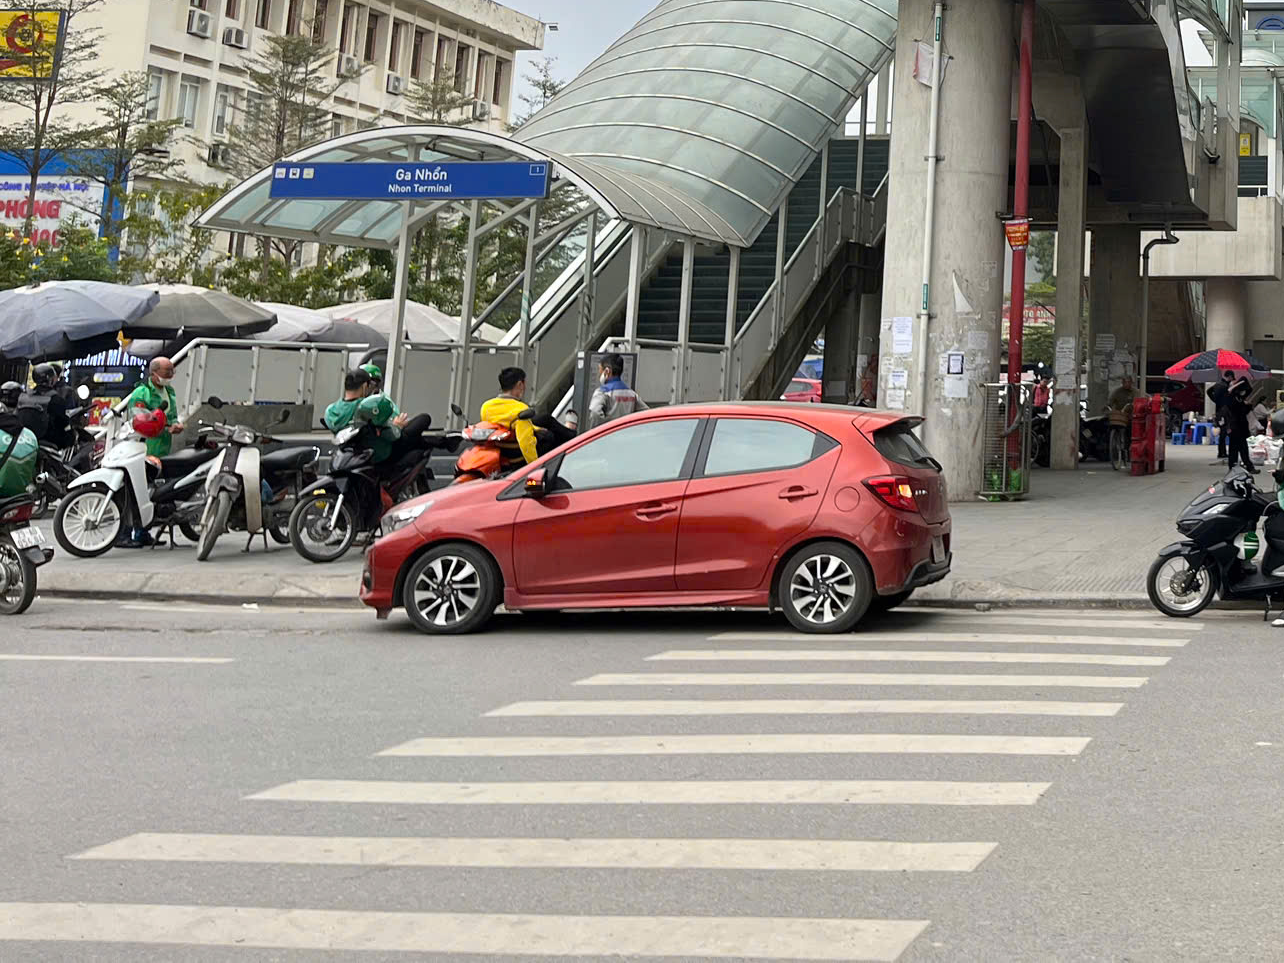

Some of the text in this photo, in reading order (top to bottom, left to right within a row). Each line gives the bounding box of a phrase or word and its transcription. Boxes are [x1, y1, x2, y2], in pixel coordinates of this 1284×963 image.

[396, 168, 412, 181] Ga
[388, 183, 452, 193] Nhon Terminal
